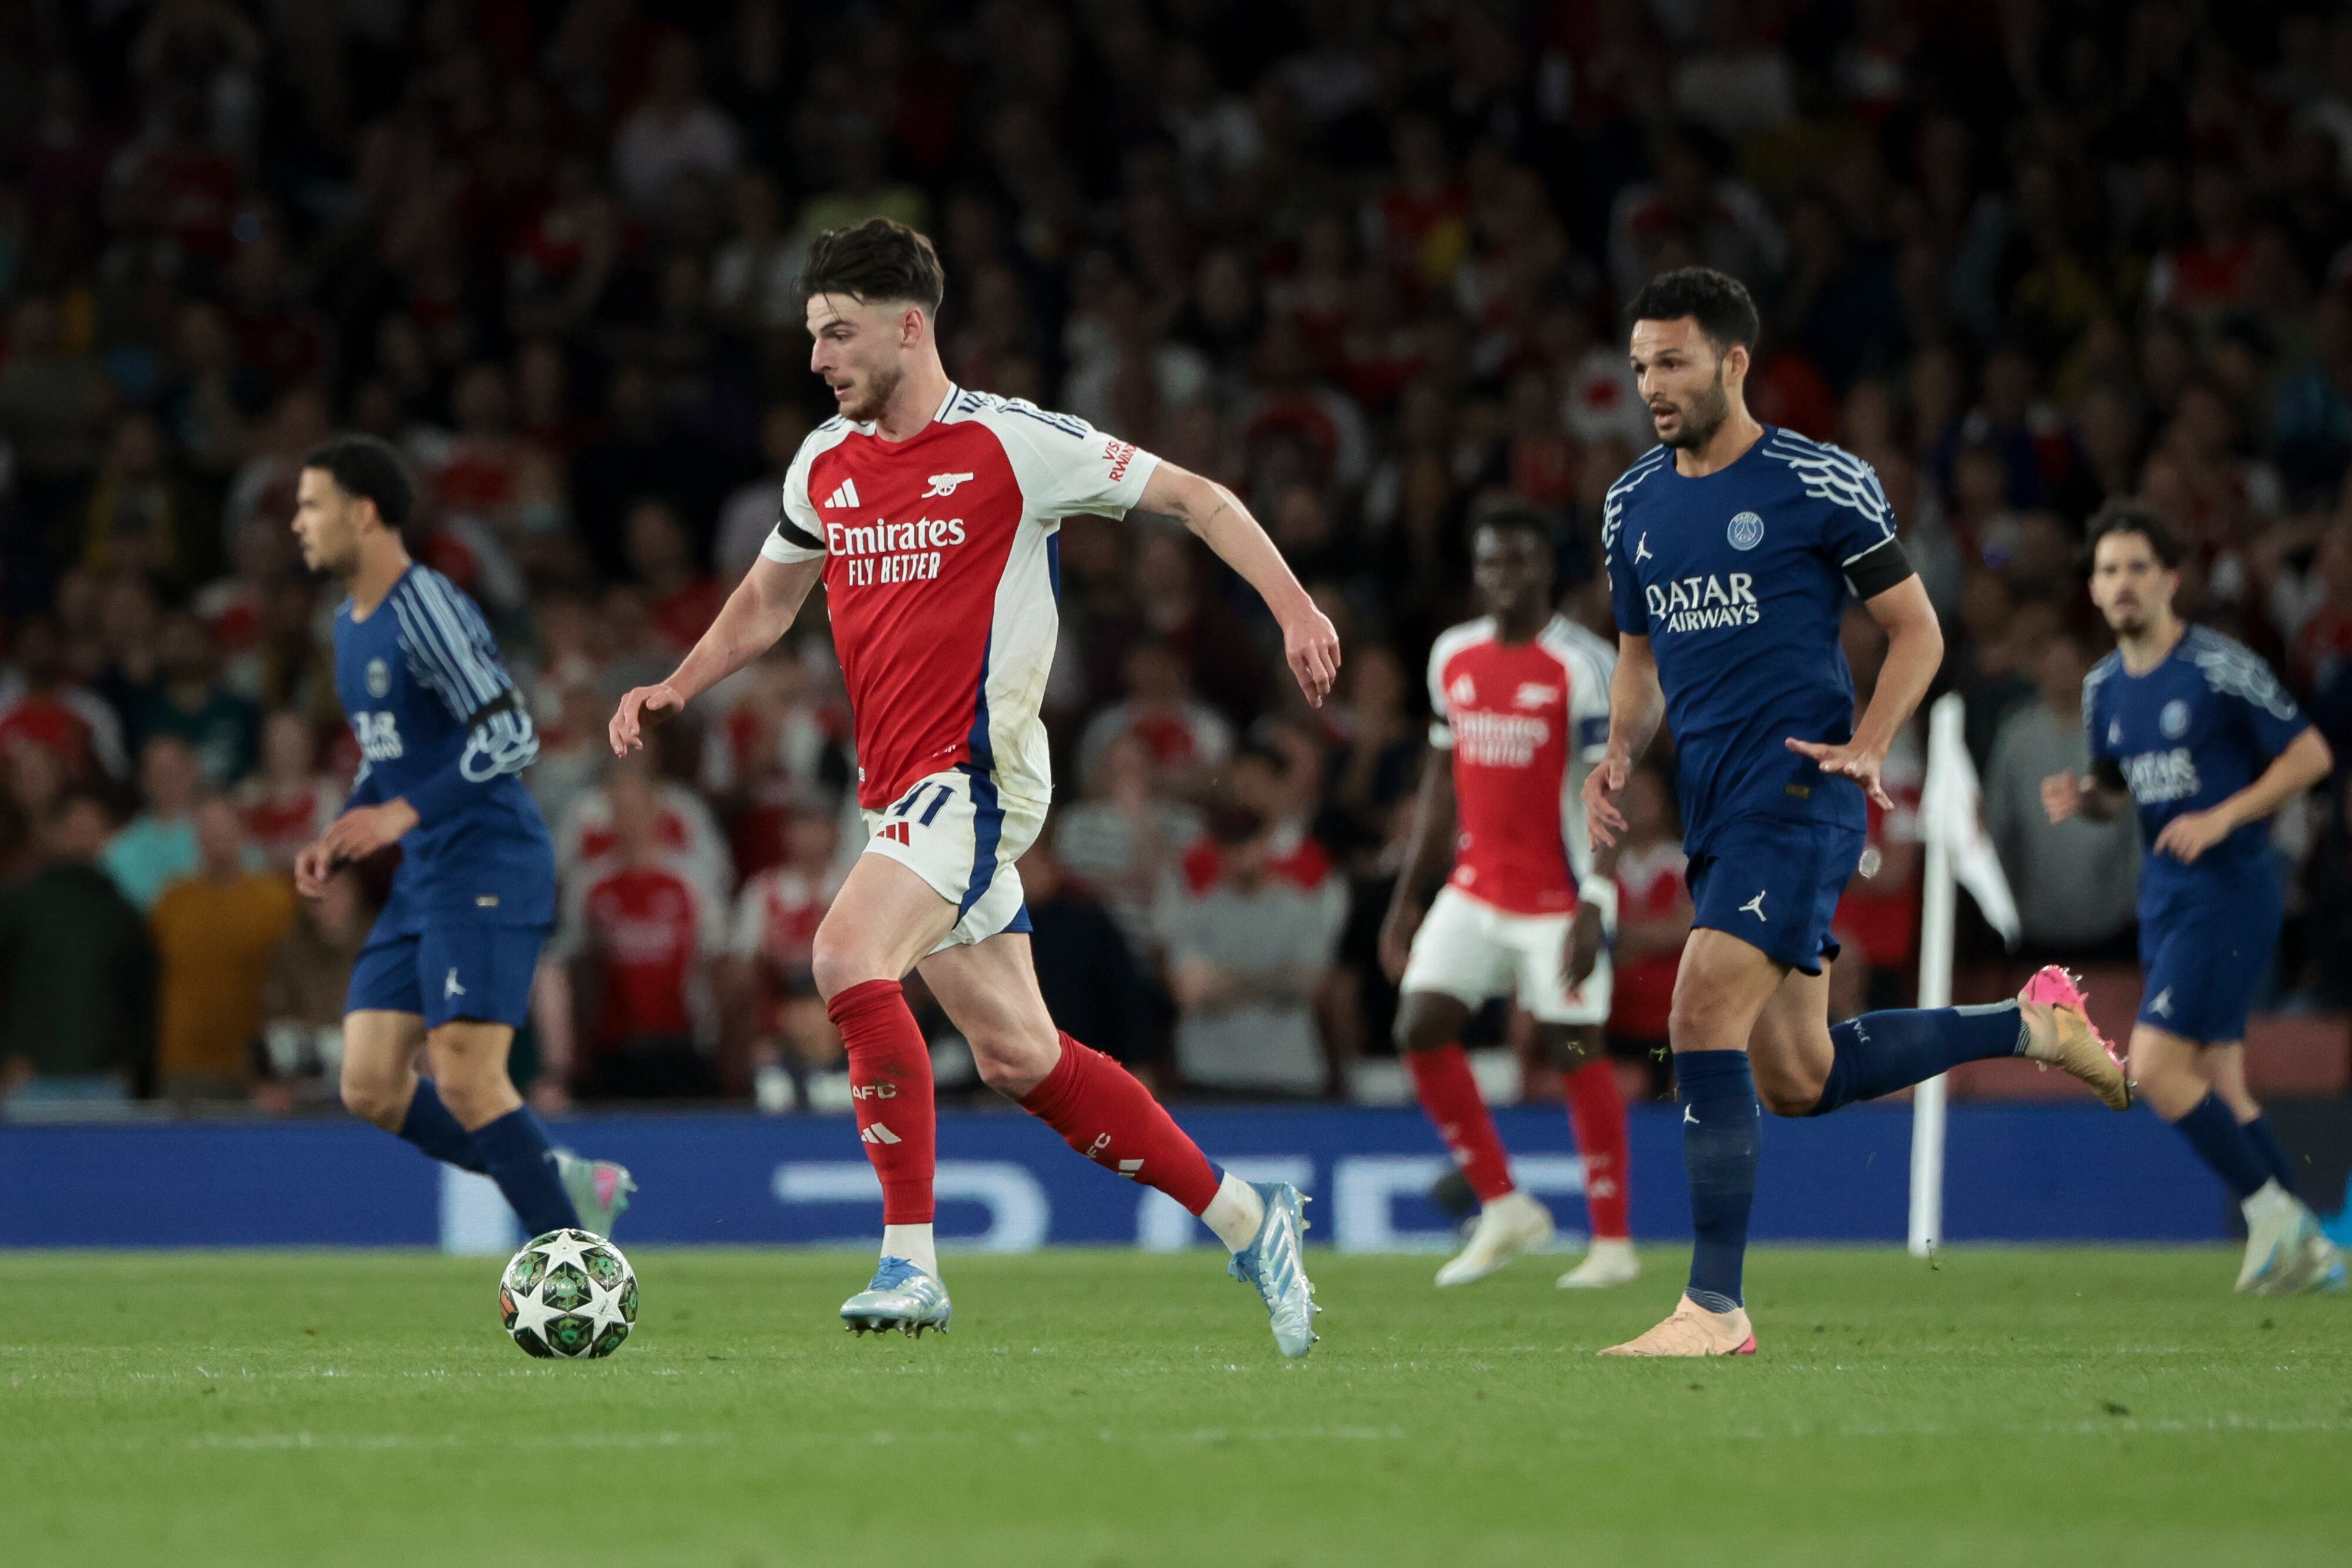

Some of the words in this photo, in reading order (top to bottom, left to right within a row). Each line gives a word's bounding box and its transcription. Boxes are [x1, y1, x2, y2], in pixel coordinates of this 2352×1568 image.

[826, 516, 965, 556] Emirates
[848, 559, 874, 586] FLY
[880, 551, 941, 584] BETTER
[1645, 573, 1758, 620] QATAR
[1667, 603, 1760, 633] AIRWAYS
[852, 1084, 896, 1100] AFC
[1086, 1132, 1111, 1159] FC
